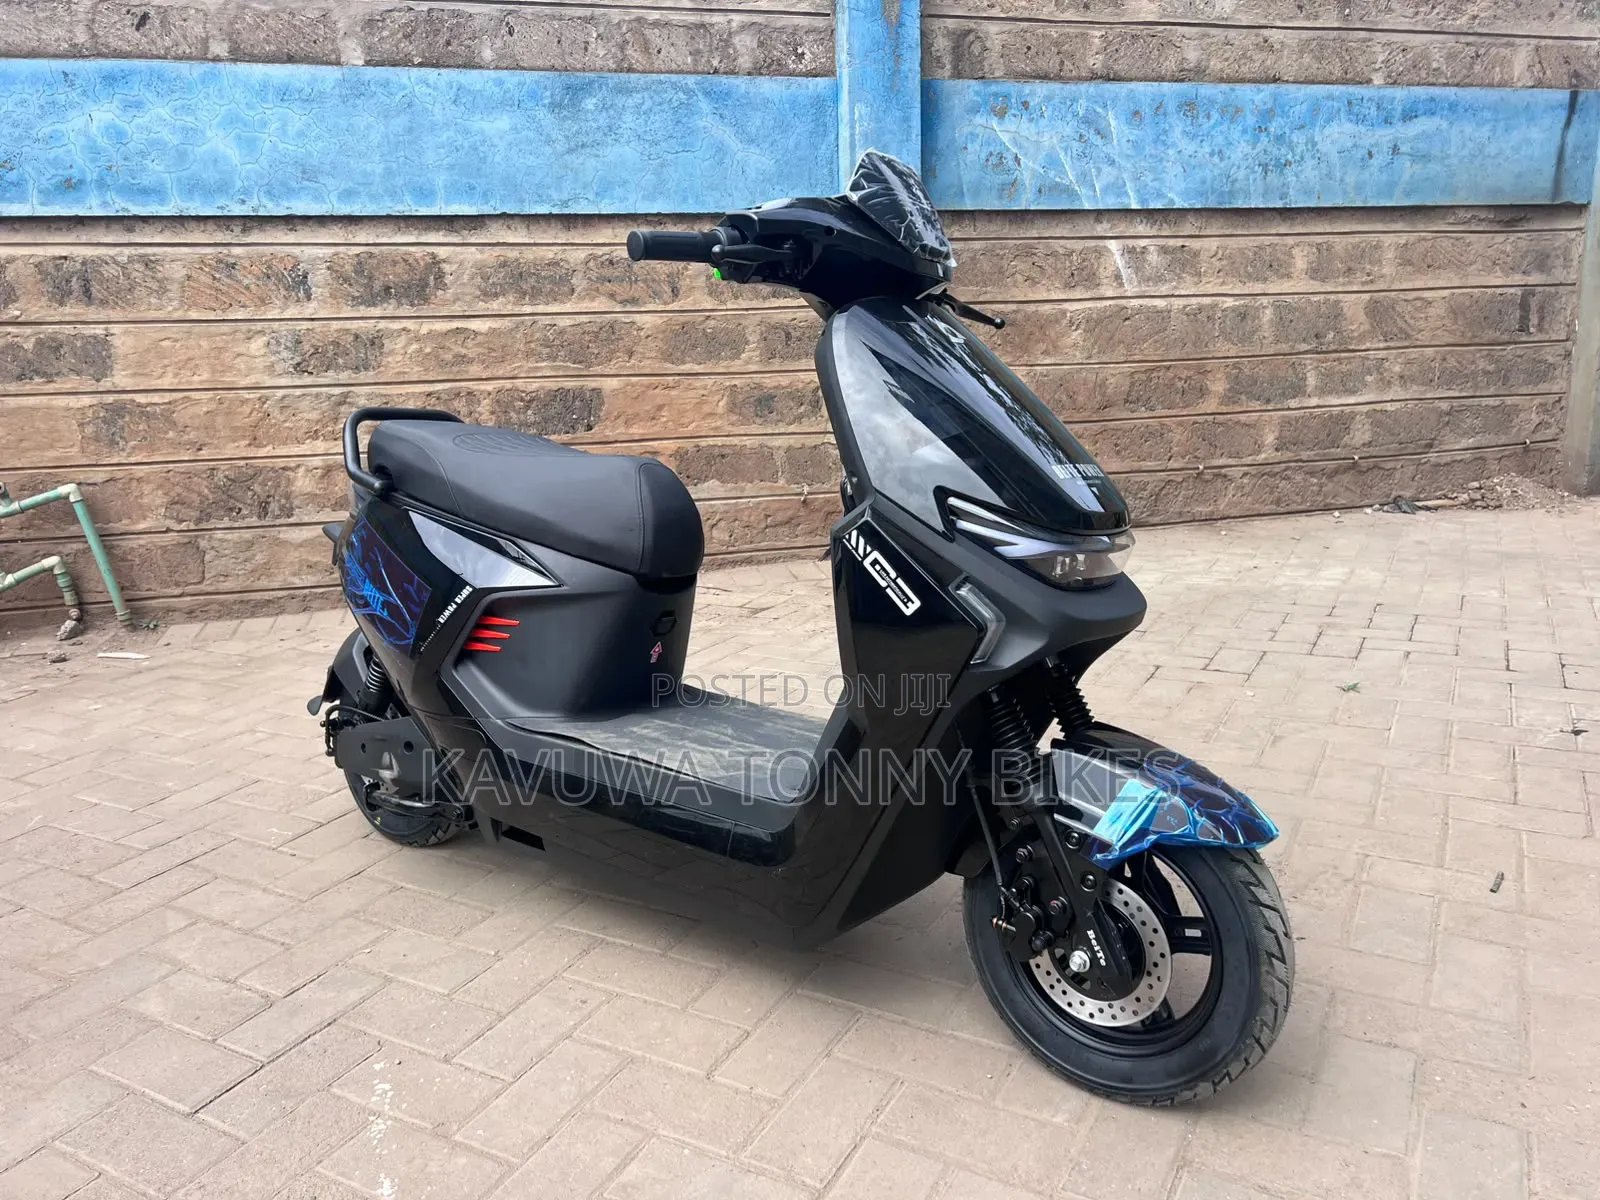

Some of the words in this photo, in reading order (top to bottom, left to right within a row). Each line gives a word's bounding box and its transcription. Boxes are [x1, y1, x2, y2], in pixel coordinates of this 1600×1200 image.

[454, 585, 473, 604] SUPER
[438, 602, 457, 624] POWER
[1086, 929, 1106, 967] BeiTe
